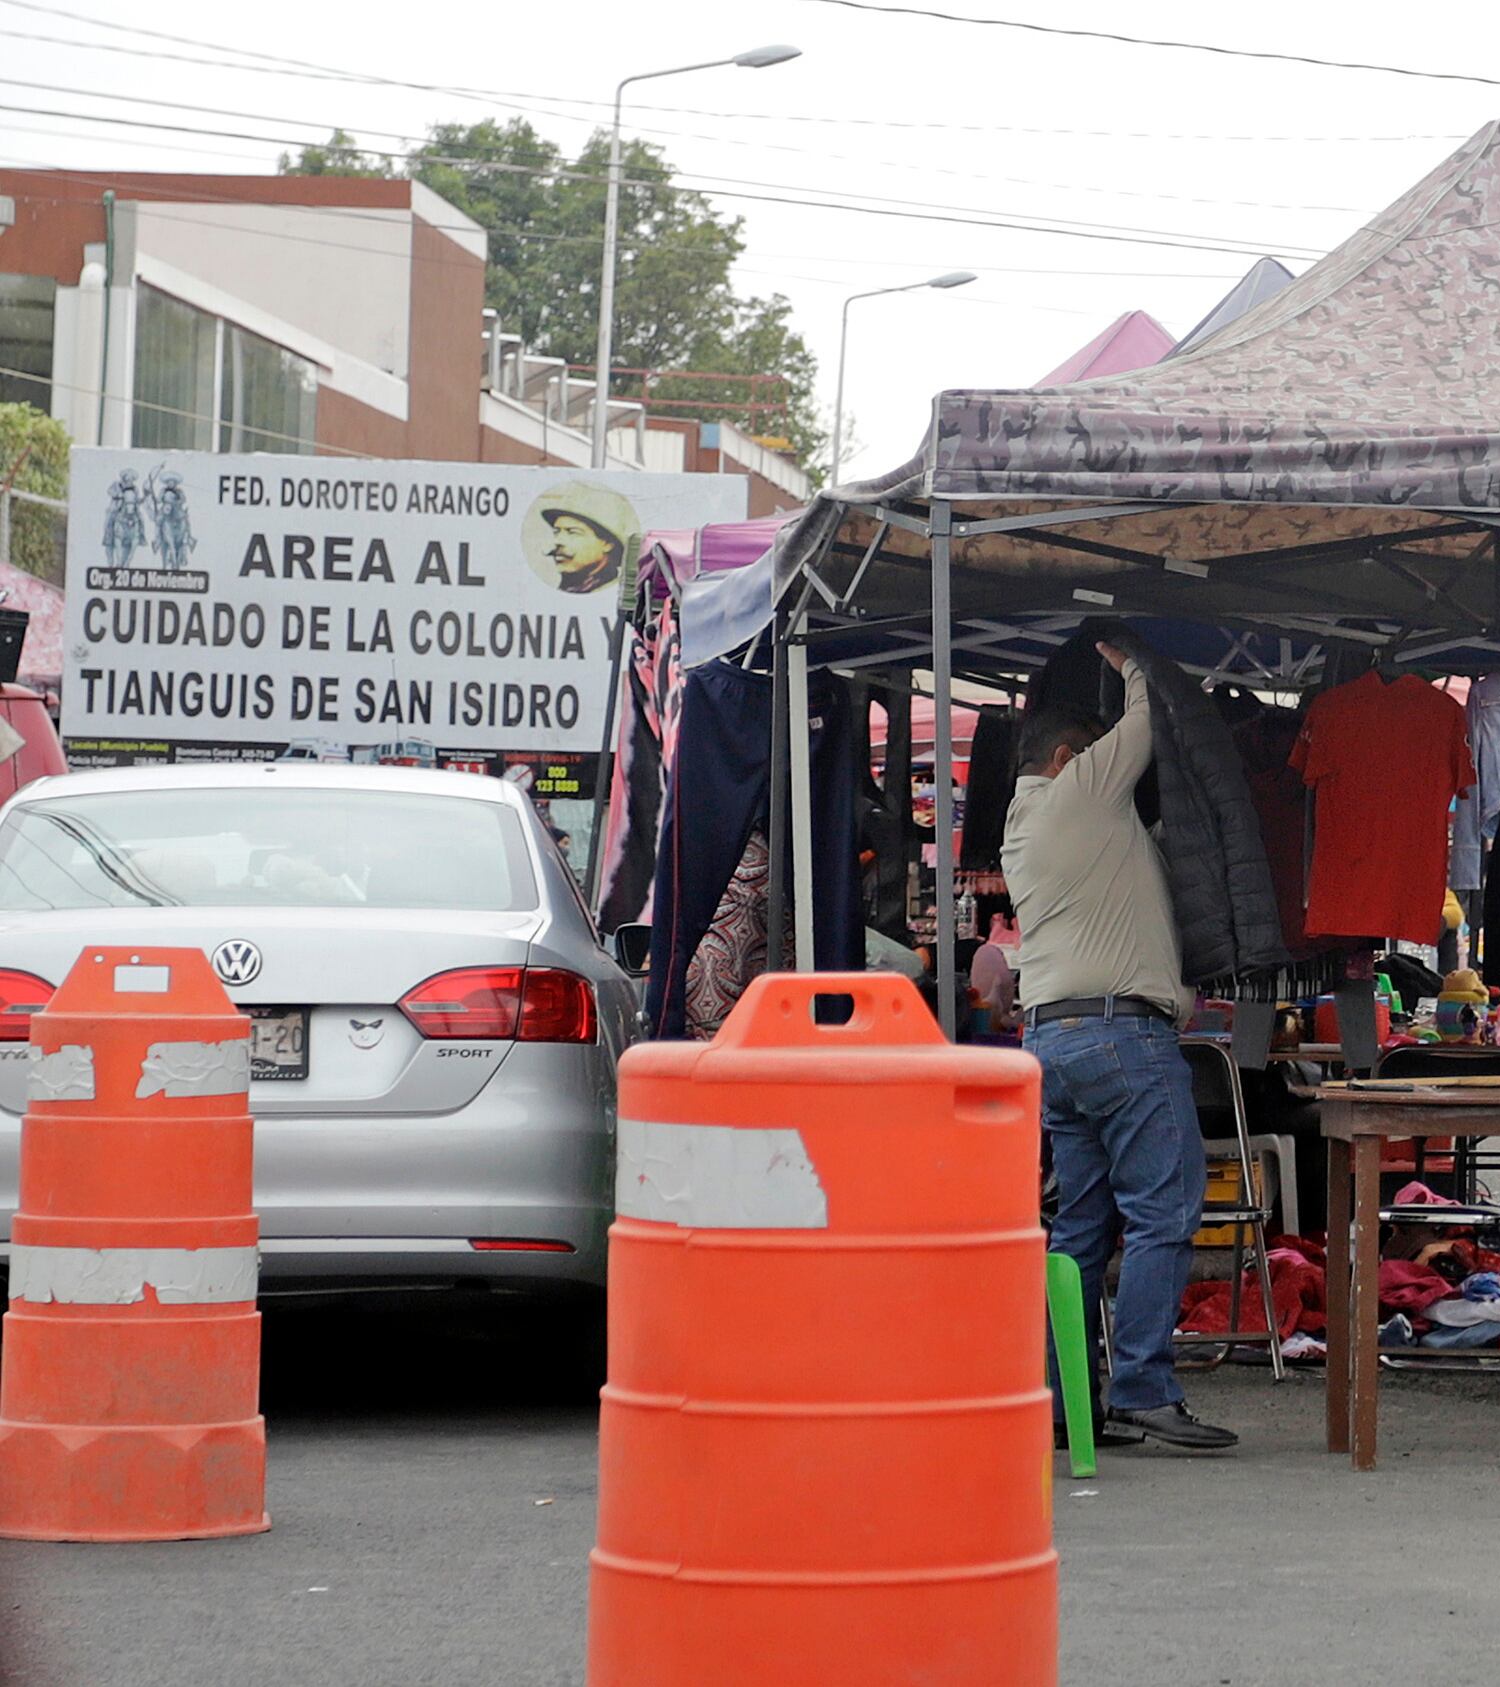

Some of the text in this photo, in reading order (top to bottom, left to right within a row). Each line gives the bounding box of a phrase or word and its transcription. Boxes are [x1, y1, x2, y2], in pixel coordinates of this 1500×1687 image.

[219, 475, 509, 516] FED. DOROTEO ARANGO
[115, 570, 130, 587] 20
[131, 571, 146, 588] de
[147, 571, 206, 590] Noviembre
[238, 533, 485, 587] AREA AL
[83, 597, 265, 648] CUIDADO
[282, 605, 330, 651] DE
[347, 607, 394, 653] LA
[410, 609, 585, 660] COLONIA
[80, 668, 579, 729] TIANGUIS DE SAN ISIDRO
[437, 1048, 493, 1058] SPORT
